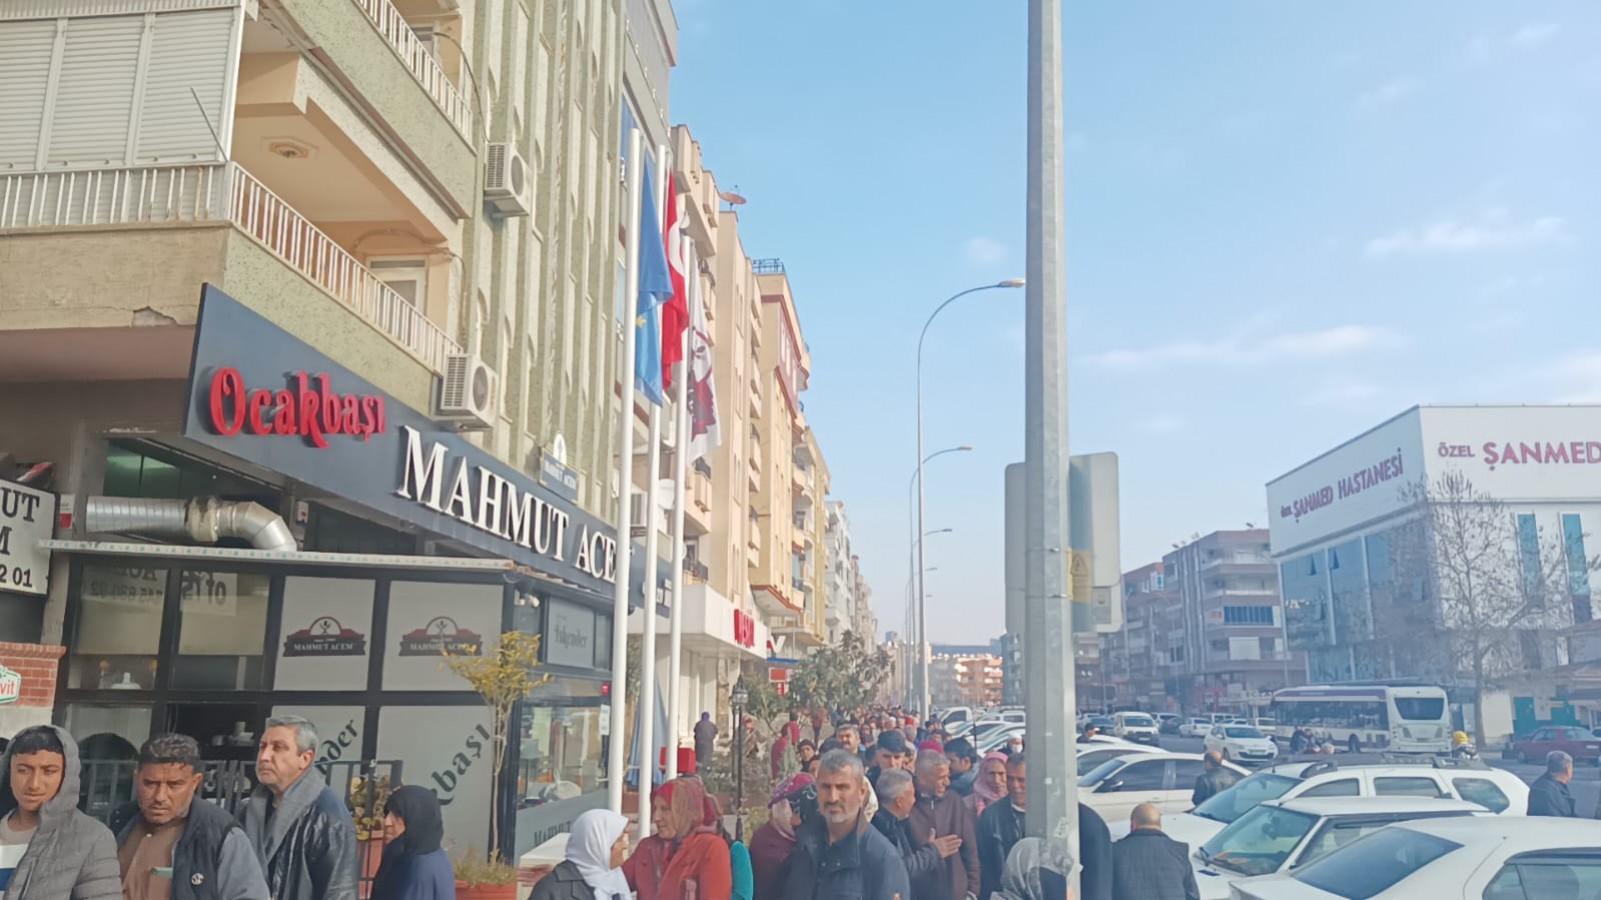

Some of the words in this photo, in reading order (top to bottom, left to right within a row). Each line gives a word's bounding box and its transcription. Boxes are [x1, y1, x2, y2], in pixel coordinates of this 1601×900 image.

[209, 366, 387, 449] Ocakbaşı
[1437, 442, 1476, 458] ÖZEL
[1482, 441, 1601, 472] ŞANMED
[396, 425, 570, 562] MAHMUT
[573, 523, 617, 585] ACE
[1293, 485, 1334, 523] ŞANMED
[1338, 447, 1403, 500] HASTANESİ
[12, 566, 33, 588] 01
[294, 643, 330, 651] MAHMUT
[331, 643, 354, 651] ACEM
